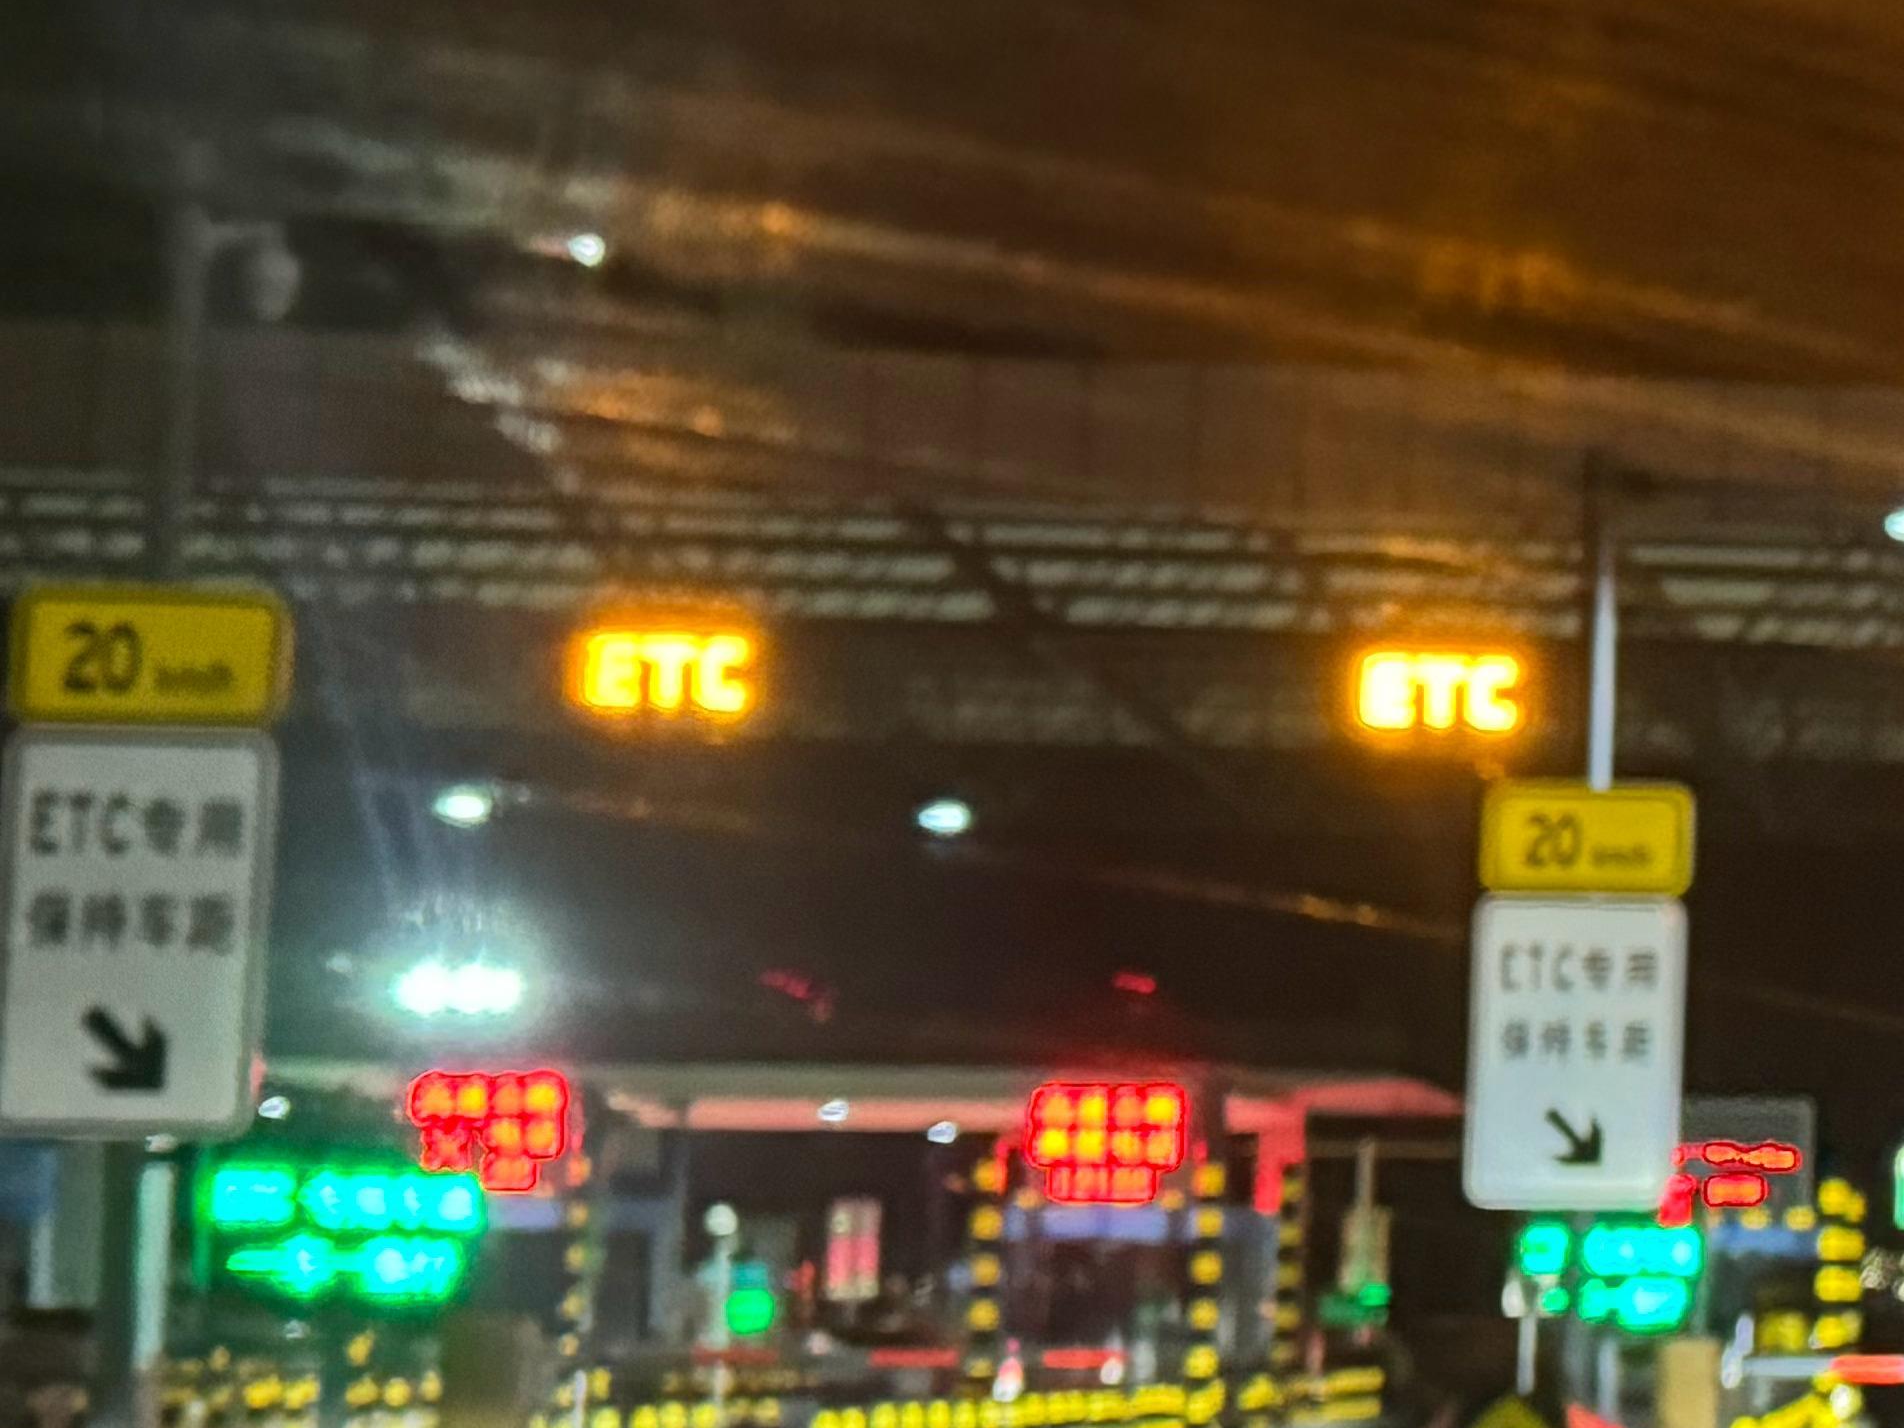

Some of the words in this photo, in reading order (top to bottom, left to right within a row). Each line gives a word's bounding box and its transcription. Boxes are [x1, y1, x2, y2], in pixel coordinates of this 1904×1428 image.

[62, 620, 145, 694] 20
[584, 632, 749, 714] ETC
[1359, 652, 1520, 732] ETC
[1523, 810, 1583, 869] 20
